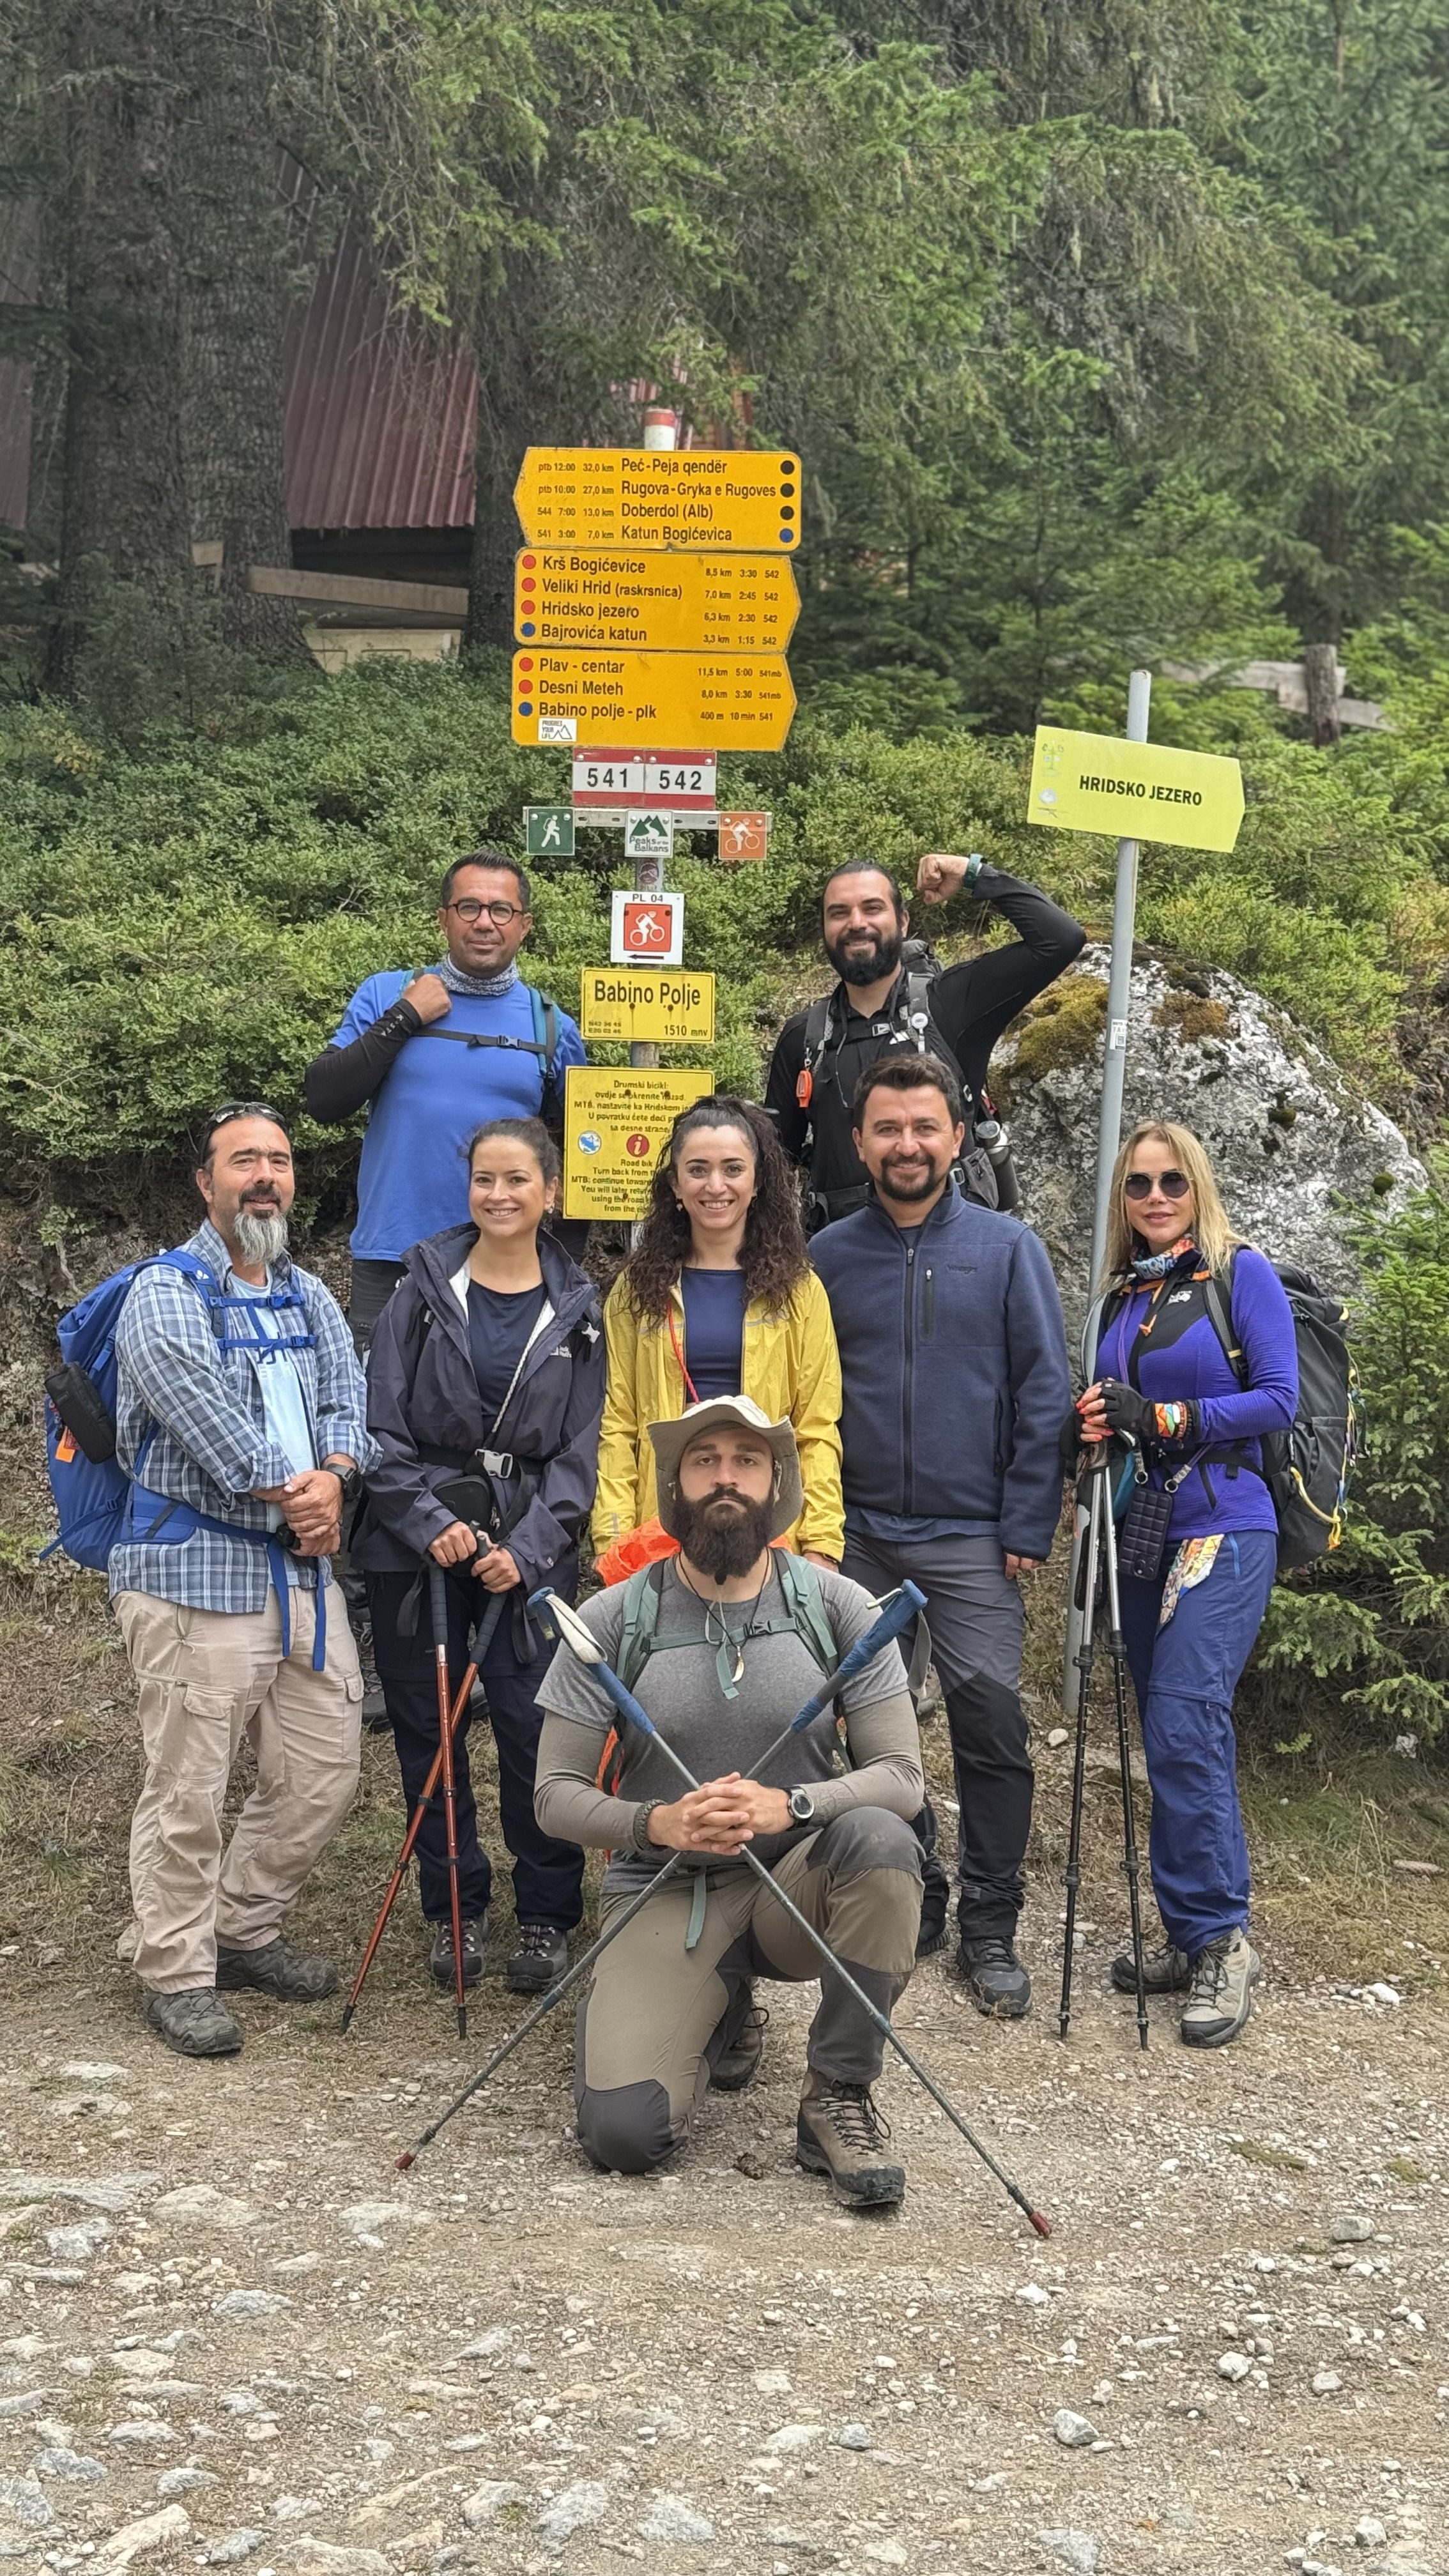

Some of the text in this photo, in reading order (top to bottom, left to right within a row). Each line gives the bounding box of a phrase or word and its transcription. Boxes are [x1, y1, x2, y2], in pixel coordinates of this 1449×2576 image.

[554, 463, 576, 471] 12:00
[583, 463, 600, 473] 32,0
[601, 463, 615, 472] km
[683, 460, 728, 479] qendër
[554, 486, 576, 494] 10:00
[583, 486, 600, 496] 27,0
[601, 486, 615, 494] km
[714, 486, 722, 496] e
[725, 484, 776, 500] Rugoves
[537, 503, 713, 521] 544 7:00 13,0 km Doberdol (Alb)
[537, 526, 732, 544] 541 3:00 7,0 km Katun Bogićevica
[543, 555, 779, 579] Krš Bogićevice 8,5 km 3:30 542
[543, 579, 779, 601] Veliki Hrid (raskrsnica) 7,0 km 2:45 542
[542, 602, 778, 624] Hridsko jezero 6,3 km 2:30 542
[541, 624, 777, 645] Bajrovića katun 3,3 km 1:15 542
[540, 657, 569, 672] Plav
[581, 661, 625, 674] centar
[698, 668, 714, 678] 11,5
[716, 668, 728, 677] km
[735, 668, 753, 677] 5:00
[540, 680, 578, 694] Desni
[582, 681, 624, 696] Meteh
[702, 690, 714, 700] 8,0
[715, 691, 728, 700] km
[735, 691, 753, 700] 3:30
[540, 702, 587, 717] Babino
[591, 704, 625, 723] polje
[636, 705, 657, 723] plk
[700, 711, 714, 720] 400
[730, 712, 739, 721] 10
[759, 712, 773, 721] 541
[586, 767, 628, 788] 541
[659, 770, 702, 791] 542
[1079, 775, 1202, 806] HRIDSKO JEZERO
[629, 836, 656, 845] Peaks
[634, 843, 669, 852] Balkans
[632, 894, 663, 902] PL 04
[595, 979, 701, 1011] Babino Polje
[664, 1025, 687, 1036] 1510
[614, 1080, 645, 1089] Drumski
[595, 1091, 617, 1100] ovdje
[593, 1167, 610, 1175] Turn
[611, 1167, 629, 1176] back
[592, 1194, 612, 1204] using
